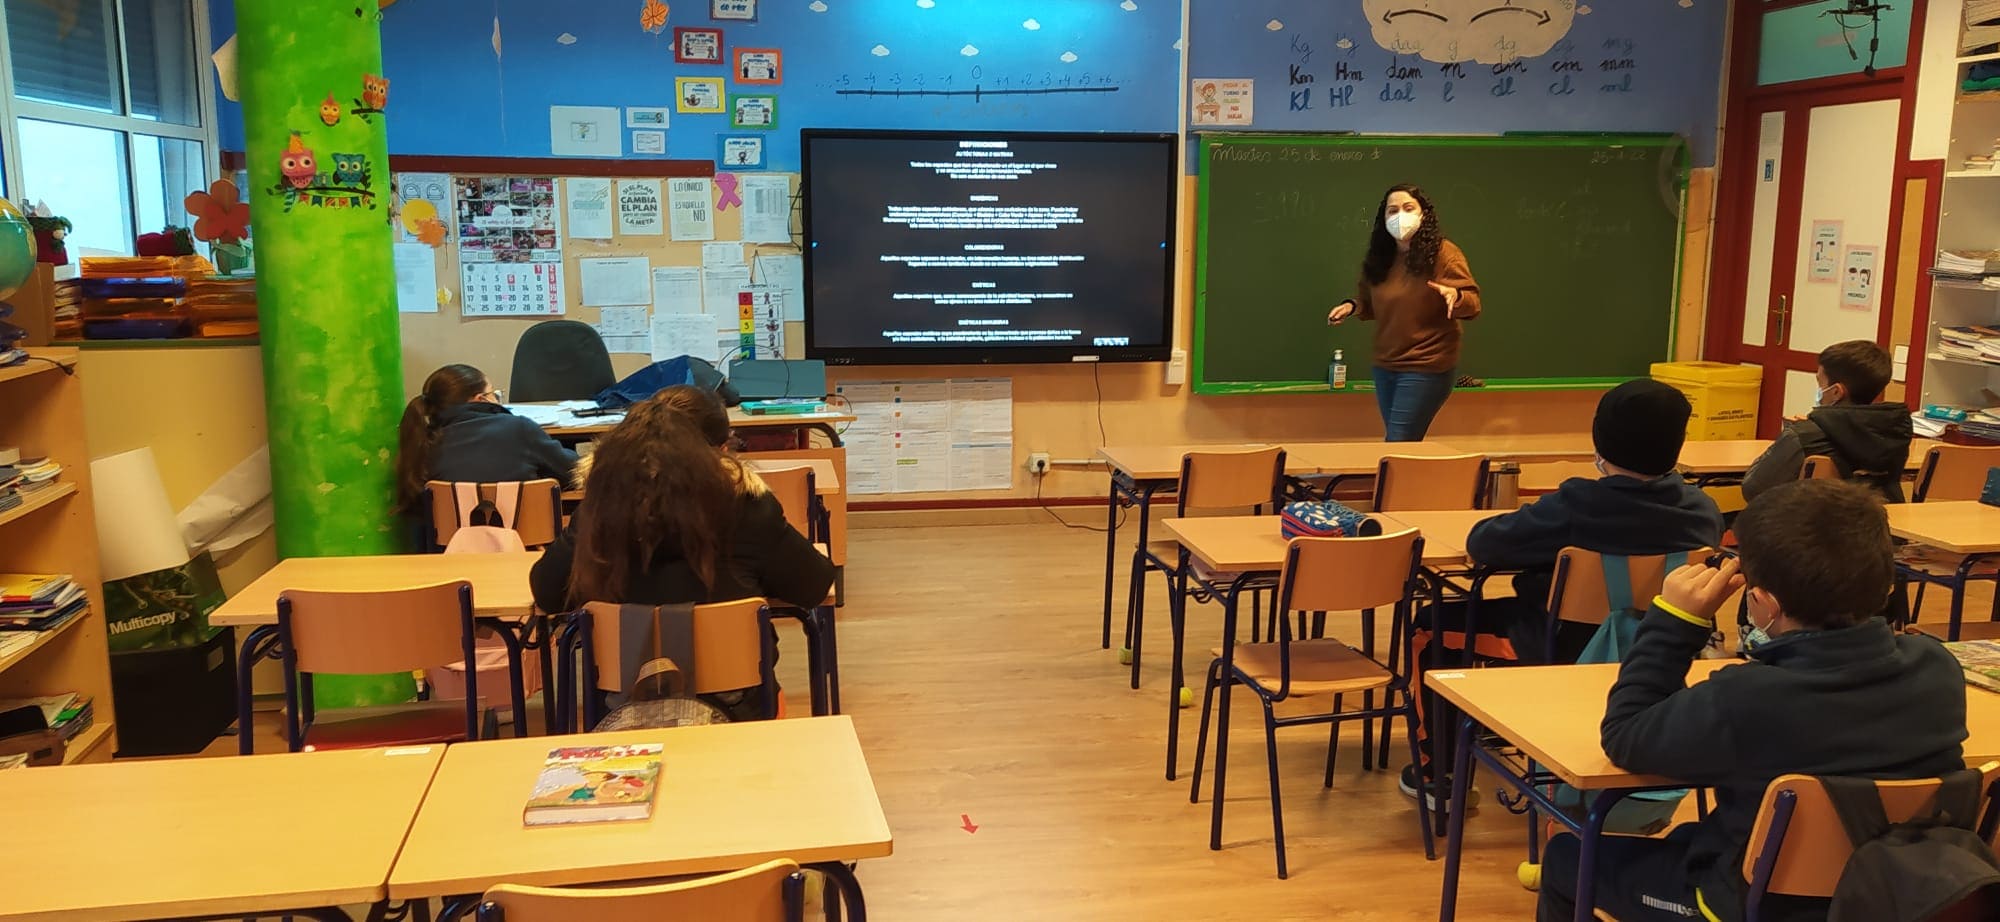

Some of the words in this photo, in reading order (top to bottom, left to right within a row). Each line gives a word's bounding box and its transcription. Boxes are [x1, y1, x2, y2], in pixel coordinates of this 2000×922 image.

[972, 65, 982, 79] 0
[1289, 63, 1314, 85] Km
[1336, 61, 1365, 81] Hm
[1386, 56, 1422, 80] dam
[1440, 62, 1466, 78] m
[1492, 54, 1527, 74] dm
[1552, 60, 1583, 72] cm
[1599, 58, 1636, 72] mm
[693, 210, 705, 222] NO
[109, 611, 176, 635] Multicopy
